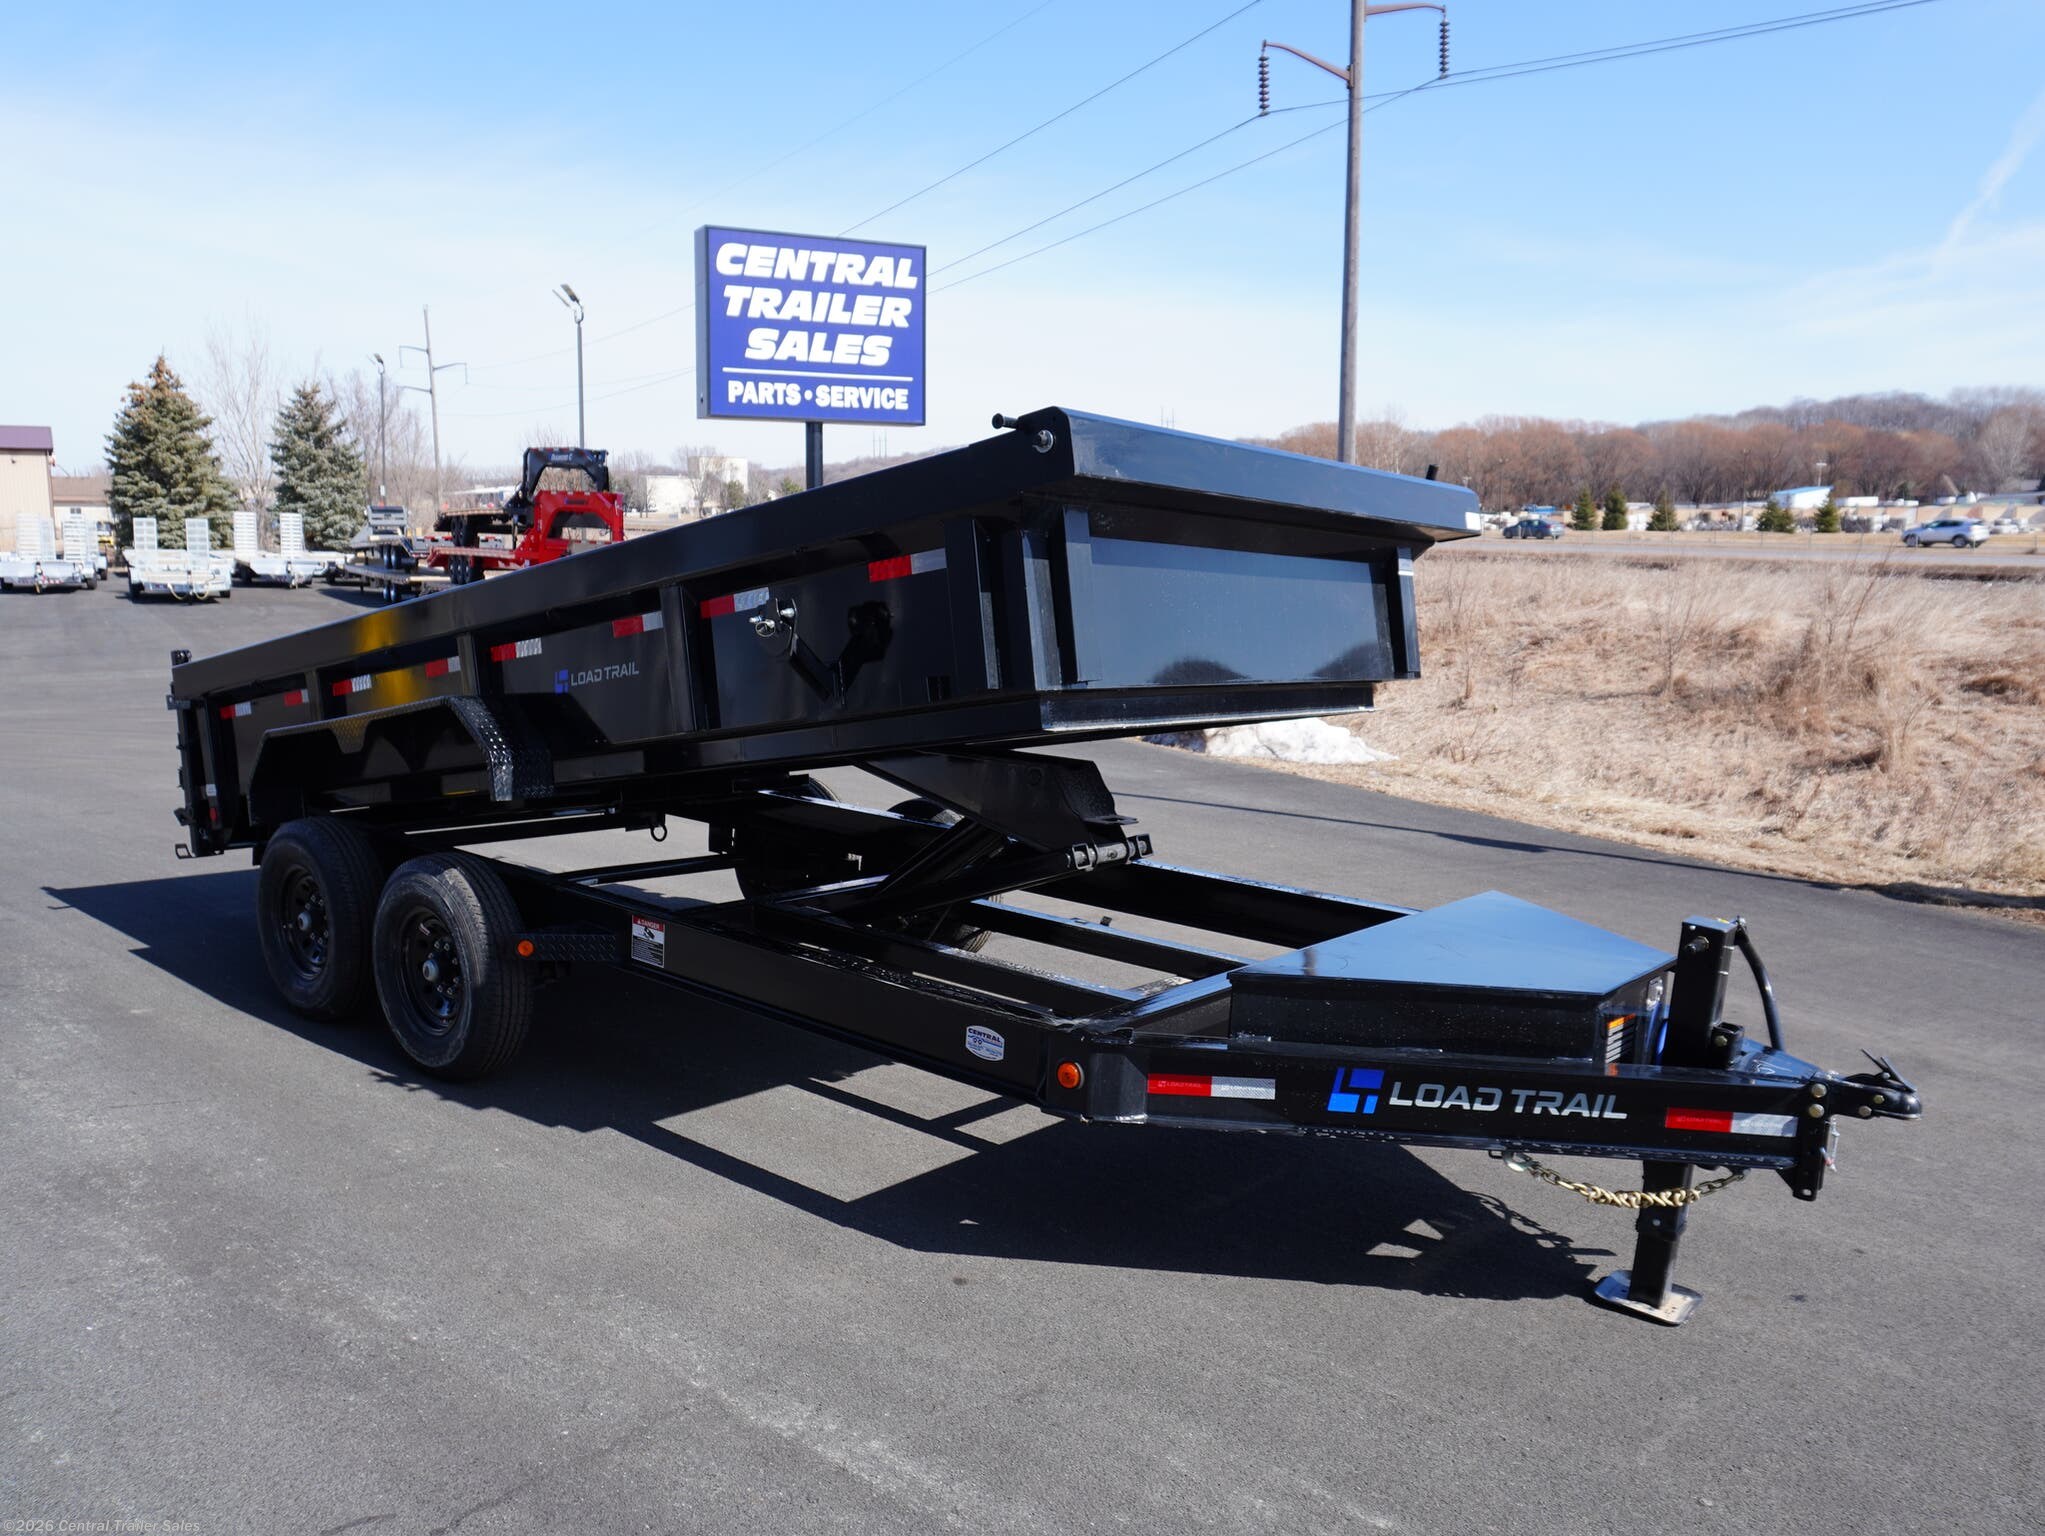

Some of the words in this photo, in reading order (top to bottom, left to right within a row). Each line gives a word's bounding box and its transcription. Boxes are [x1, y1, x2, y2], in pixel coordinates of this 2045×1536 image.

[716, 242, 918, 289] CENTRAL
[723, 285, 912, 328] TRAILER
[744, 328, 893, 367] SALES
[728, 380, 801, 406] PARTS
[815, 384, 909, 410] SERVICE
[571, 669, 602, 687] LOAD
[604, 661, 639, 680] TRAIL
[968, 1028, 1001, 1042] CENTRAL
[1389, 1081, 1503, 1112] LOAD
[1511, 1089, 1628, 1120] TRAIL
